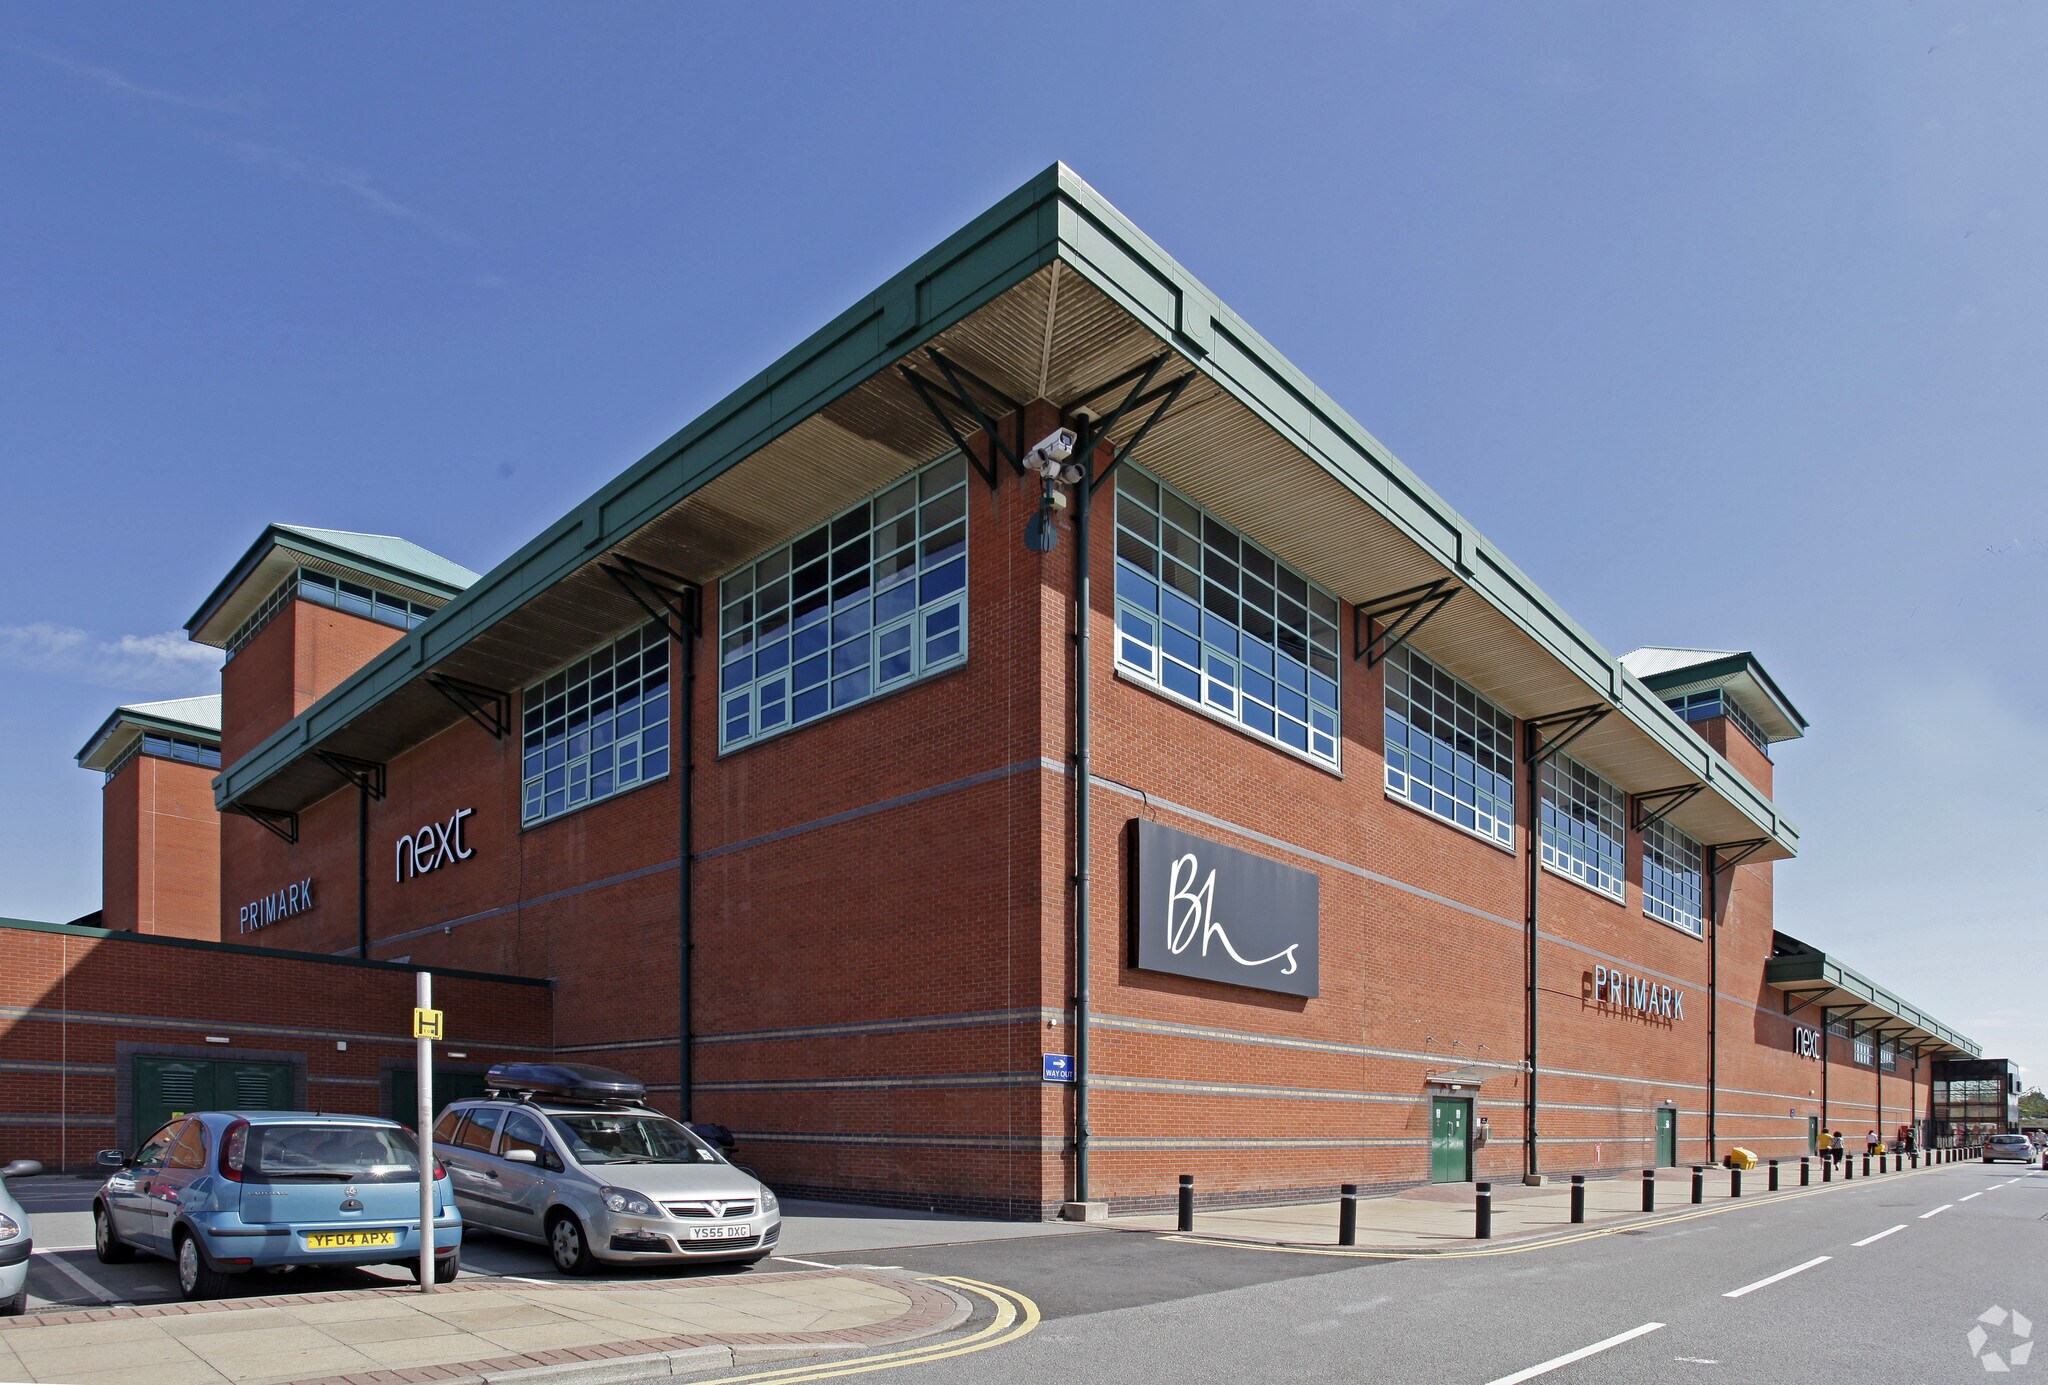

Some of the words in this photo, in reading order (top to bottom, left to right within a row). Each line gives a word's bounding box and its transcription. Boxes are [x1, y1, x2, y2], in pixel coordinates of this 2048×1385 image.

[396, 807, 472, 882] next
[240, 877, 313, 934] PRIMARK
[1167, 853, 1299, 975] Bhs
[1595, 964, 1684, 1020] PRIMARK
[418, 1011, 438, 1035] H
[1796, 1026, 1820, 1059] next
[1046, 1069, 1059, 1077] WAY
[1060, 1070, 1073, 1078] OUT
[314, 1234, 356, 1246] YF04
[361, 1232, 389, 1245] APX
[694, 1228, 723, 1238] YS55
[727, 1226, 747, 1237] DXG
